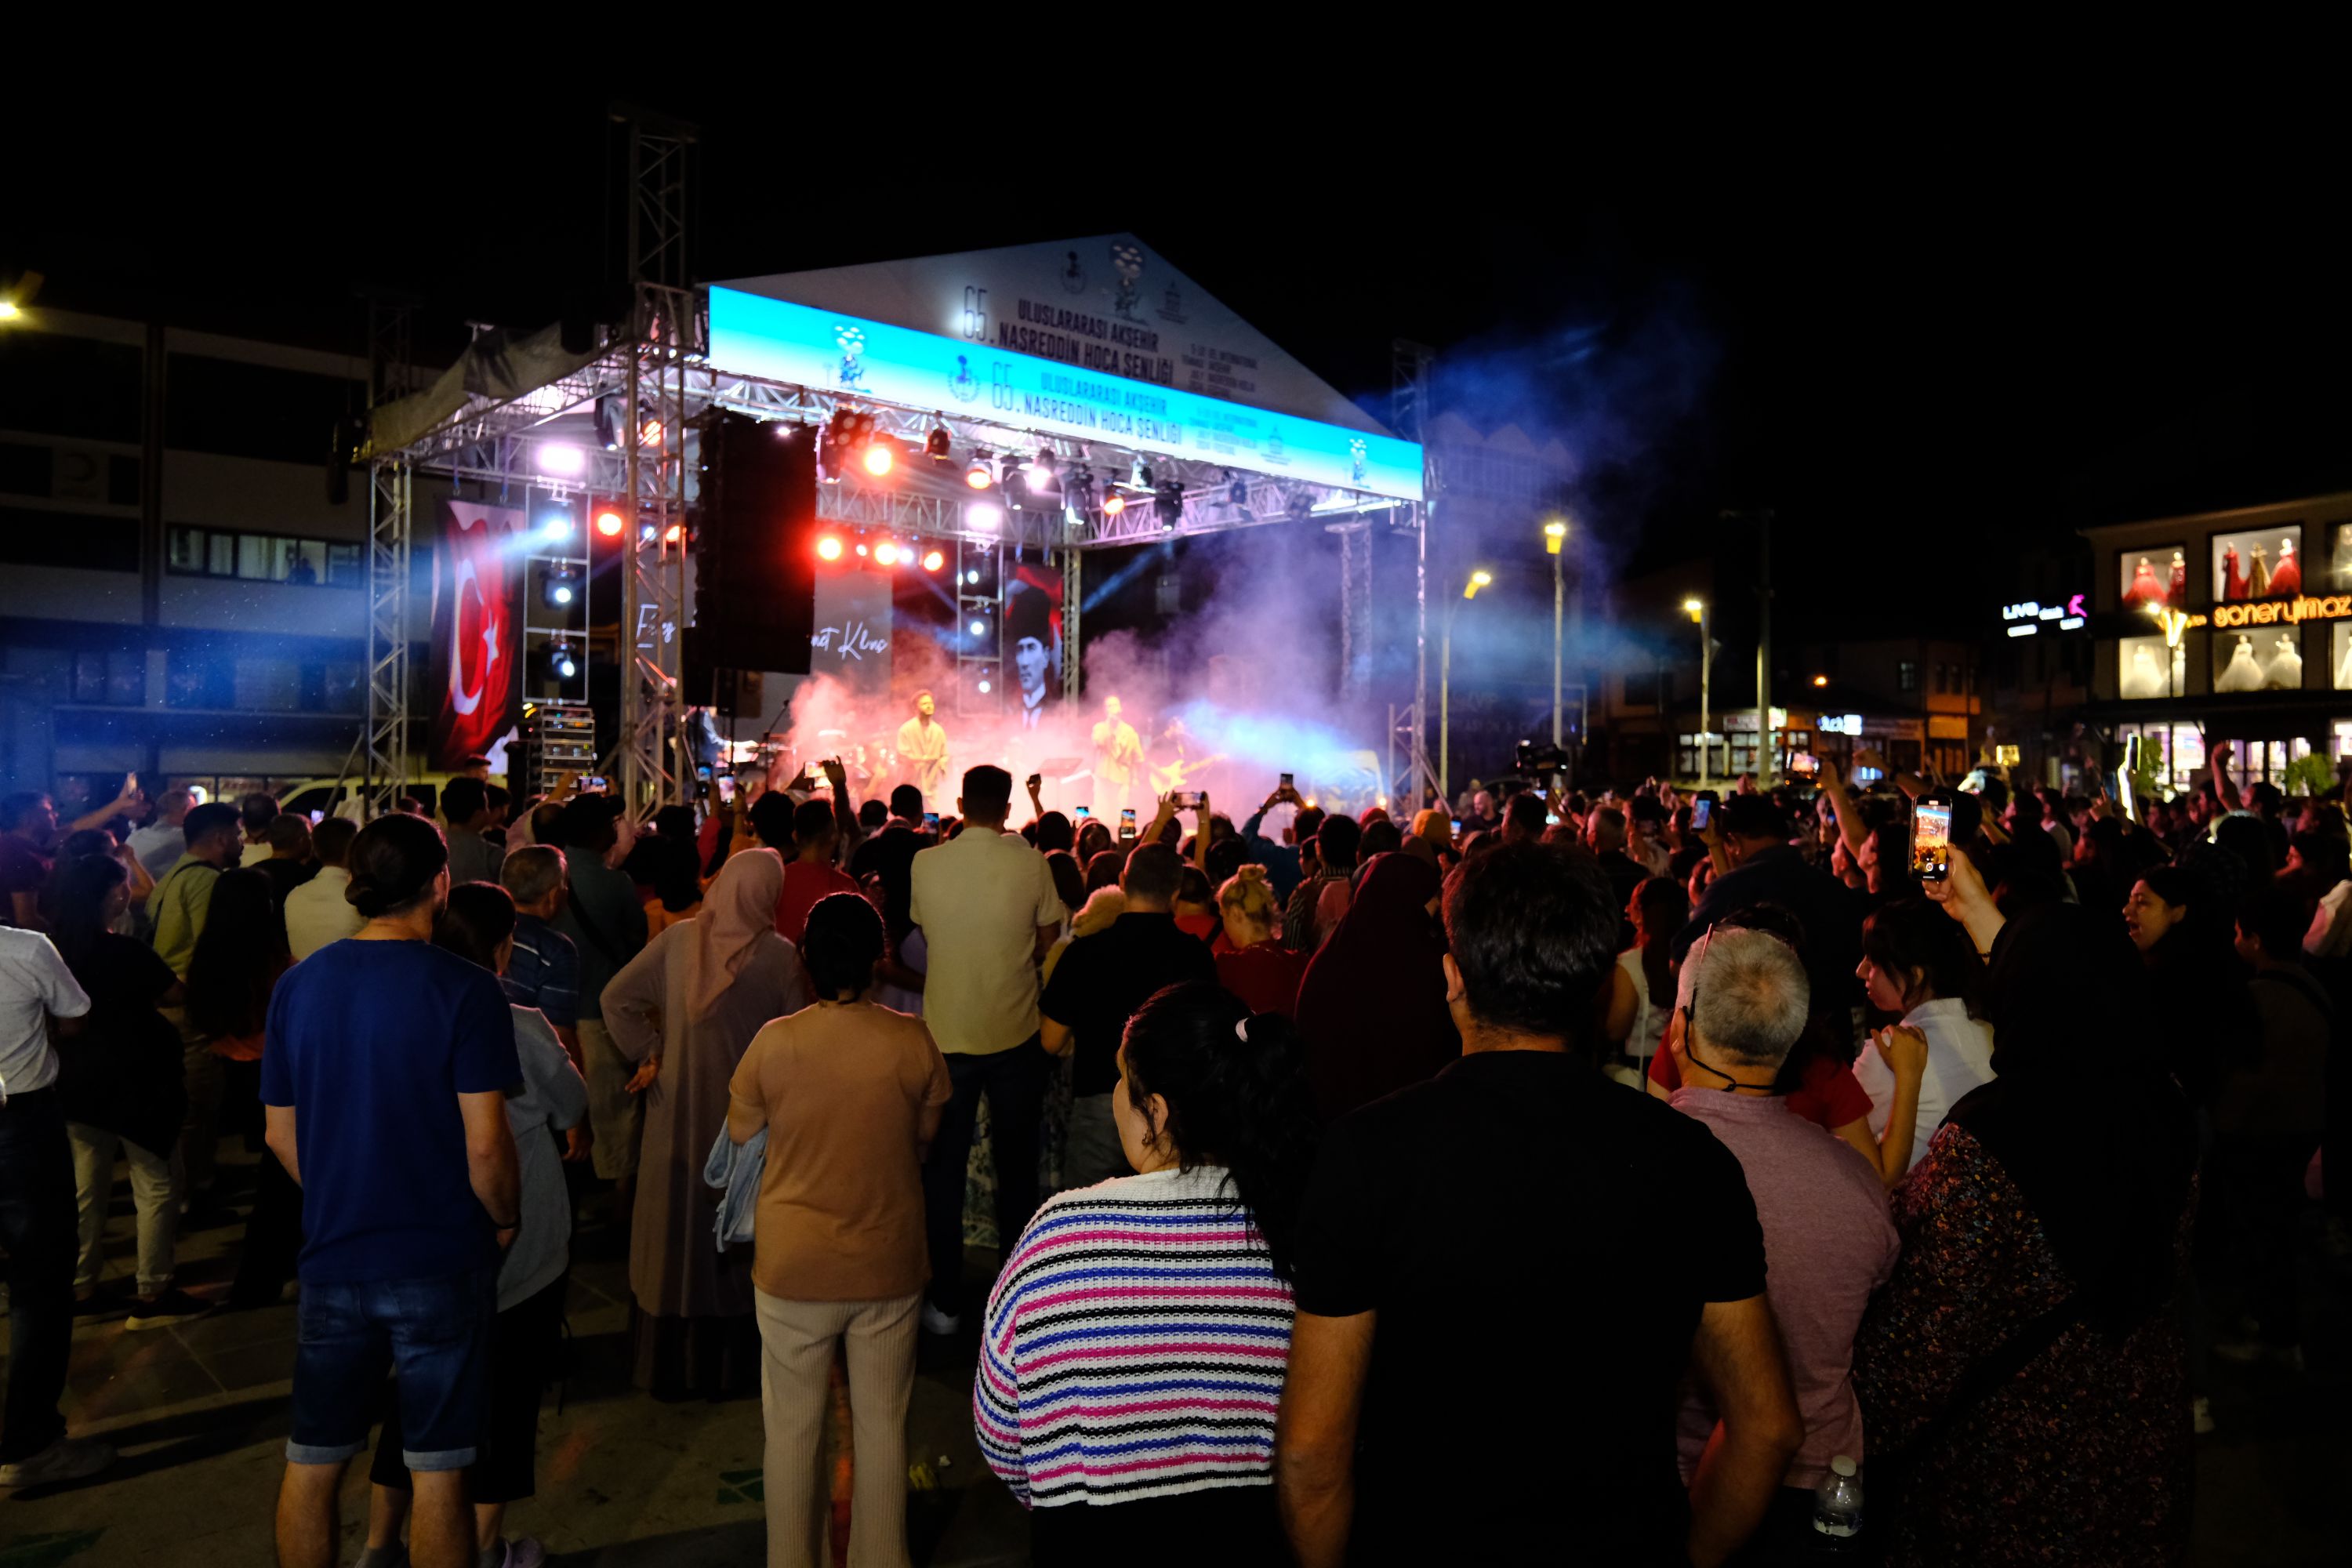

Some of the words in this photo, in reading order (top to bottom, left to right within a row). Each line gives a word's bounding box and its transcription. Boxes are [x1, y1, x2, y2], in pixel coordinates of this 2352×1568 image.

[999, 321, 1080, 364] NASREDDİN
[1084, 342, 1120, 373] HOCA
[1018, 299, 1109, 340] ULUSLARARASI
[1110, 321, 1159, 353] AKŞEHİR
[1101, 408, 1134, 435] HOCA
